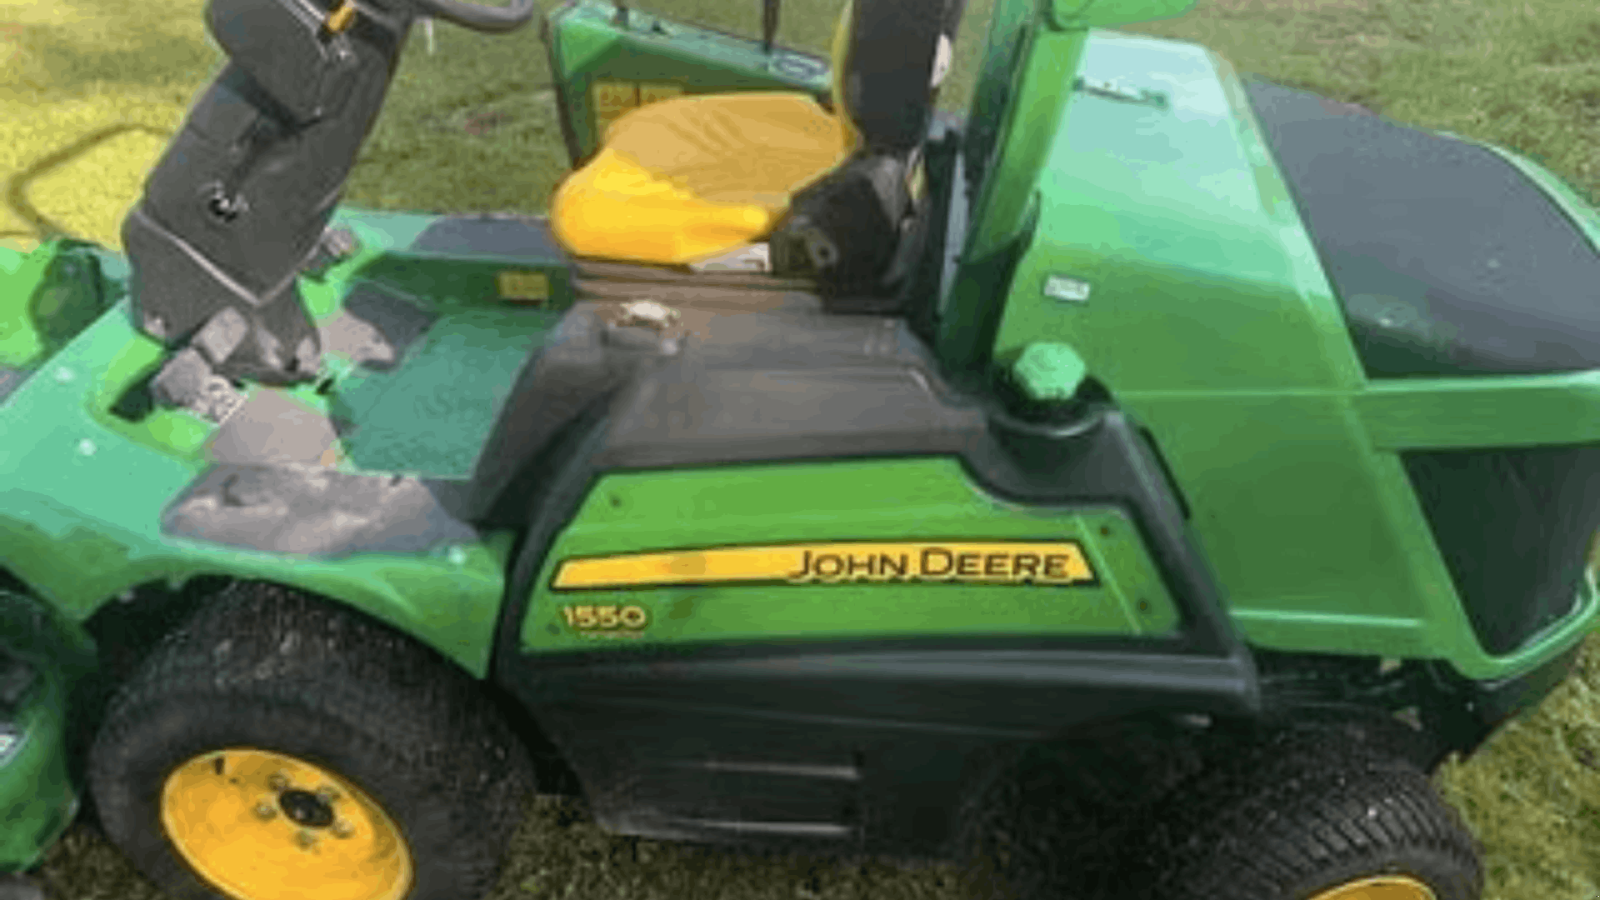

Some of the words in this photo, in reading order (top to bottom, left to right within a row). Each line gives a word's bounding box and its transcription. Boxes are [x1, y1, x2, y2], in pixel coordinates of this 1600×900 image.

[788, 549, 909, 579] JOHN
[919, 547, 1070, 579] DEERE
[563, 605, 647, 627] 1550
